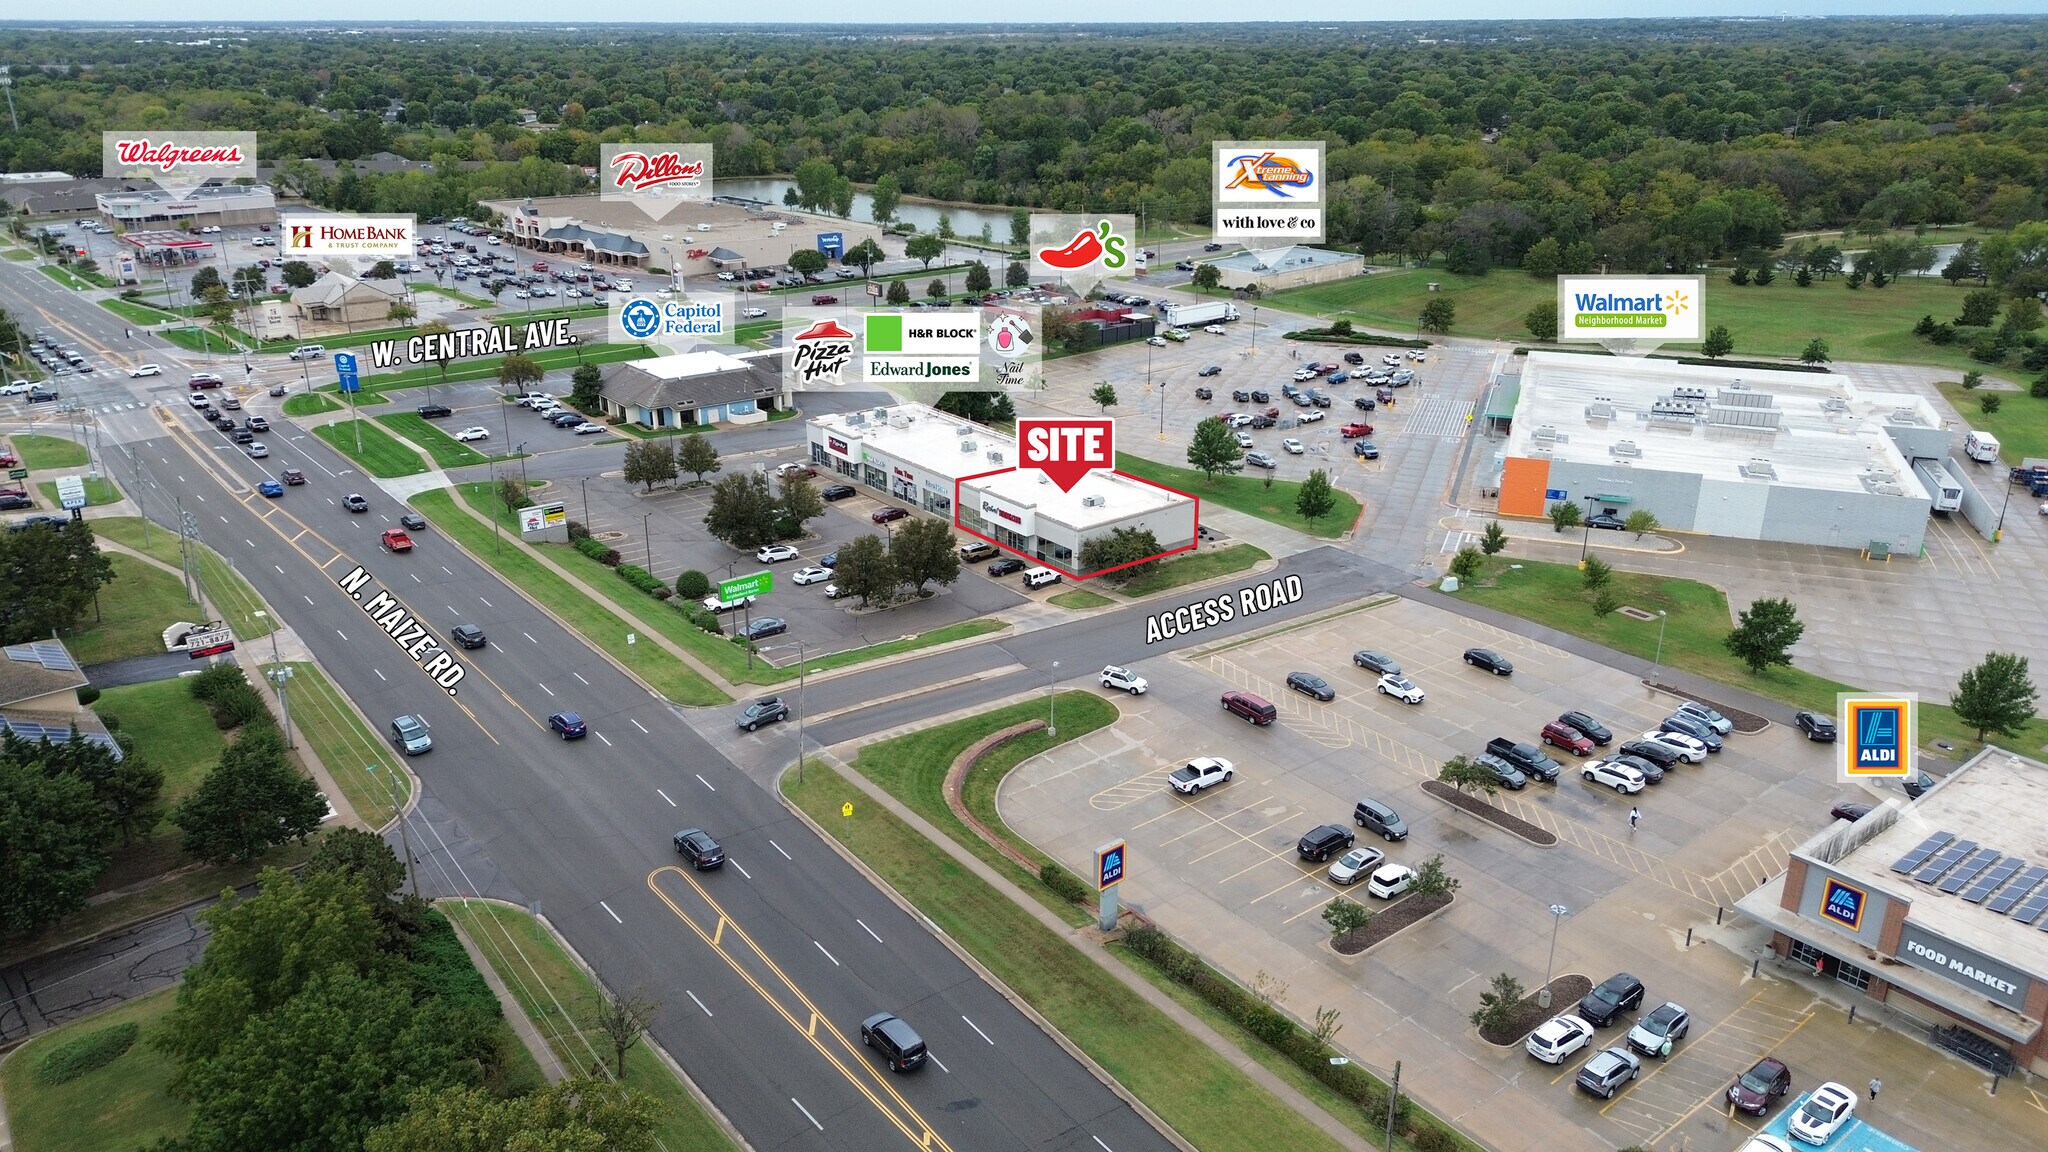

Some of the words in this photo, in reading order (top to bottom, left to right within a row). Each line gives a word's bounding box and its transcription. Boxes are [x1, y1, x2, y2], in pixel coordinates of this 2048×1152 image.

[724, 579, 759, 594] Walmart
[190, 633, 229, 648] 721-8877
[1103, 867, 1121, 881] ALDI
[1827, 904, 1855, 920] ALDI
[1907, 940, 1946, 965] FOOD
[1948, 958, 2017, 995] MARKET
